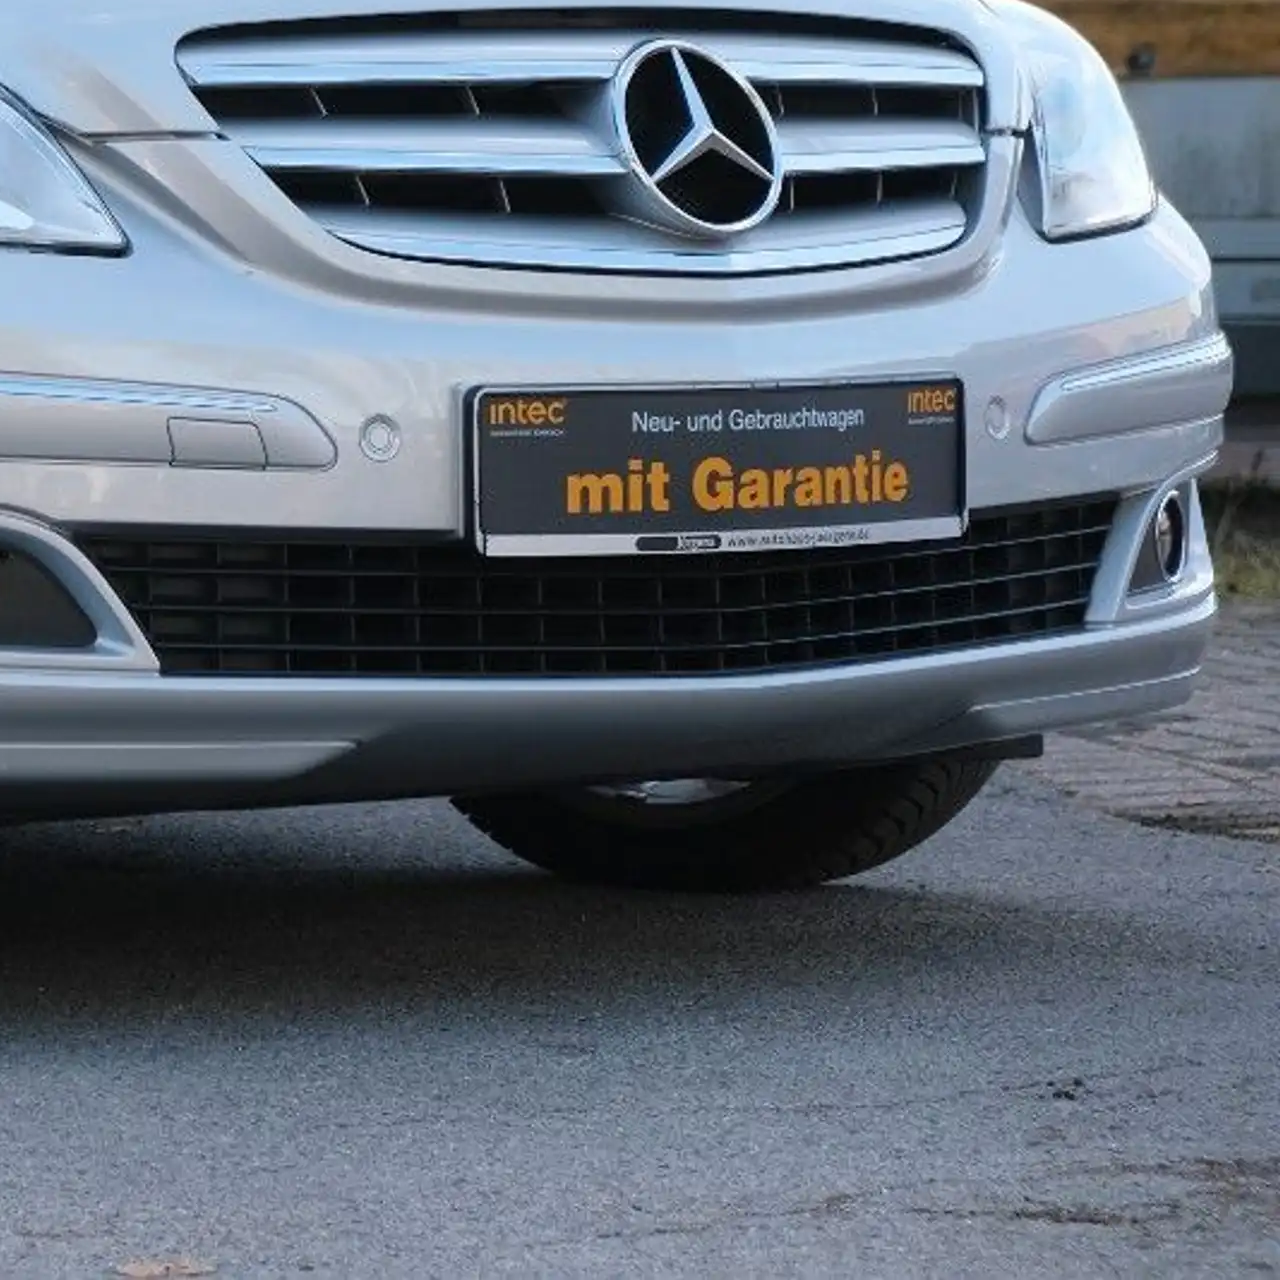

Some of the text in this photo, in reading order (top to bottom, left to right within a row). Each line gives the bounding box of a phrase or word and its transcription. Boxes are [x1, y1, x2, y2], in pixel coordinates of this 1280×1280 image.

[489, 399, 565, 425] intec
[907, 389, 955, 413] intec
[631, 407, 865, 433] Neu- und Gebrauchtwagen
[566, 448, 908, 514] mit Garantie
